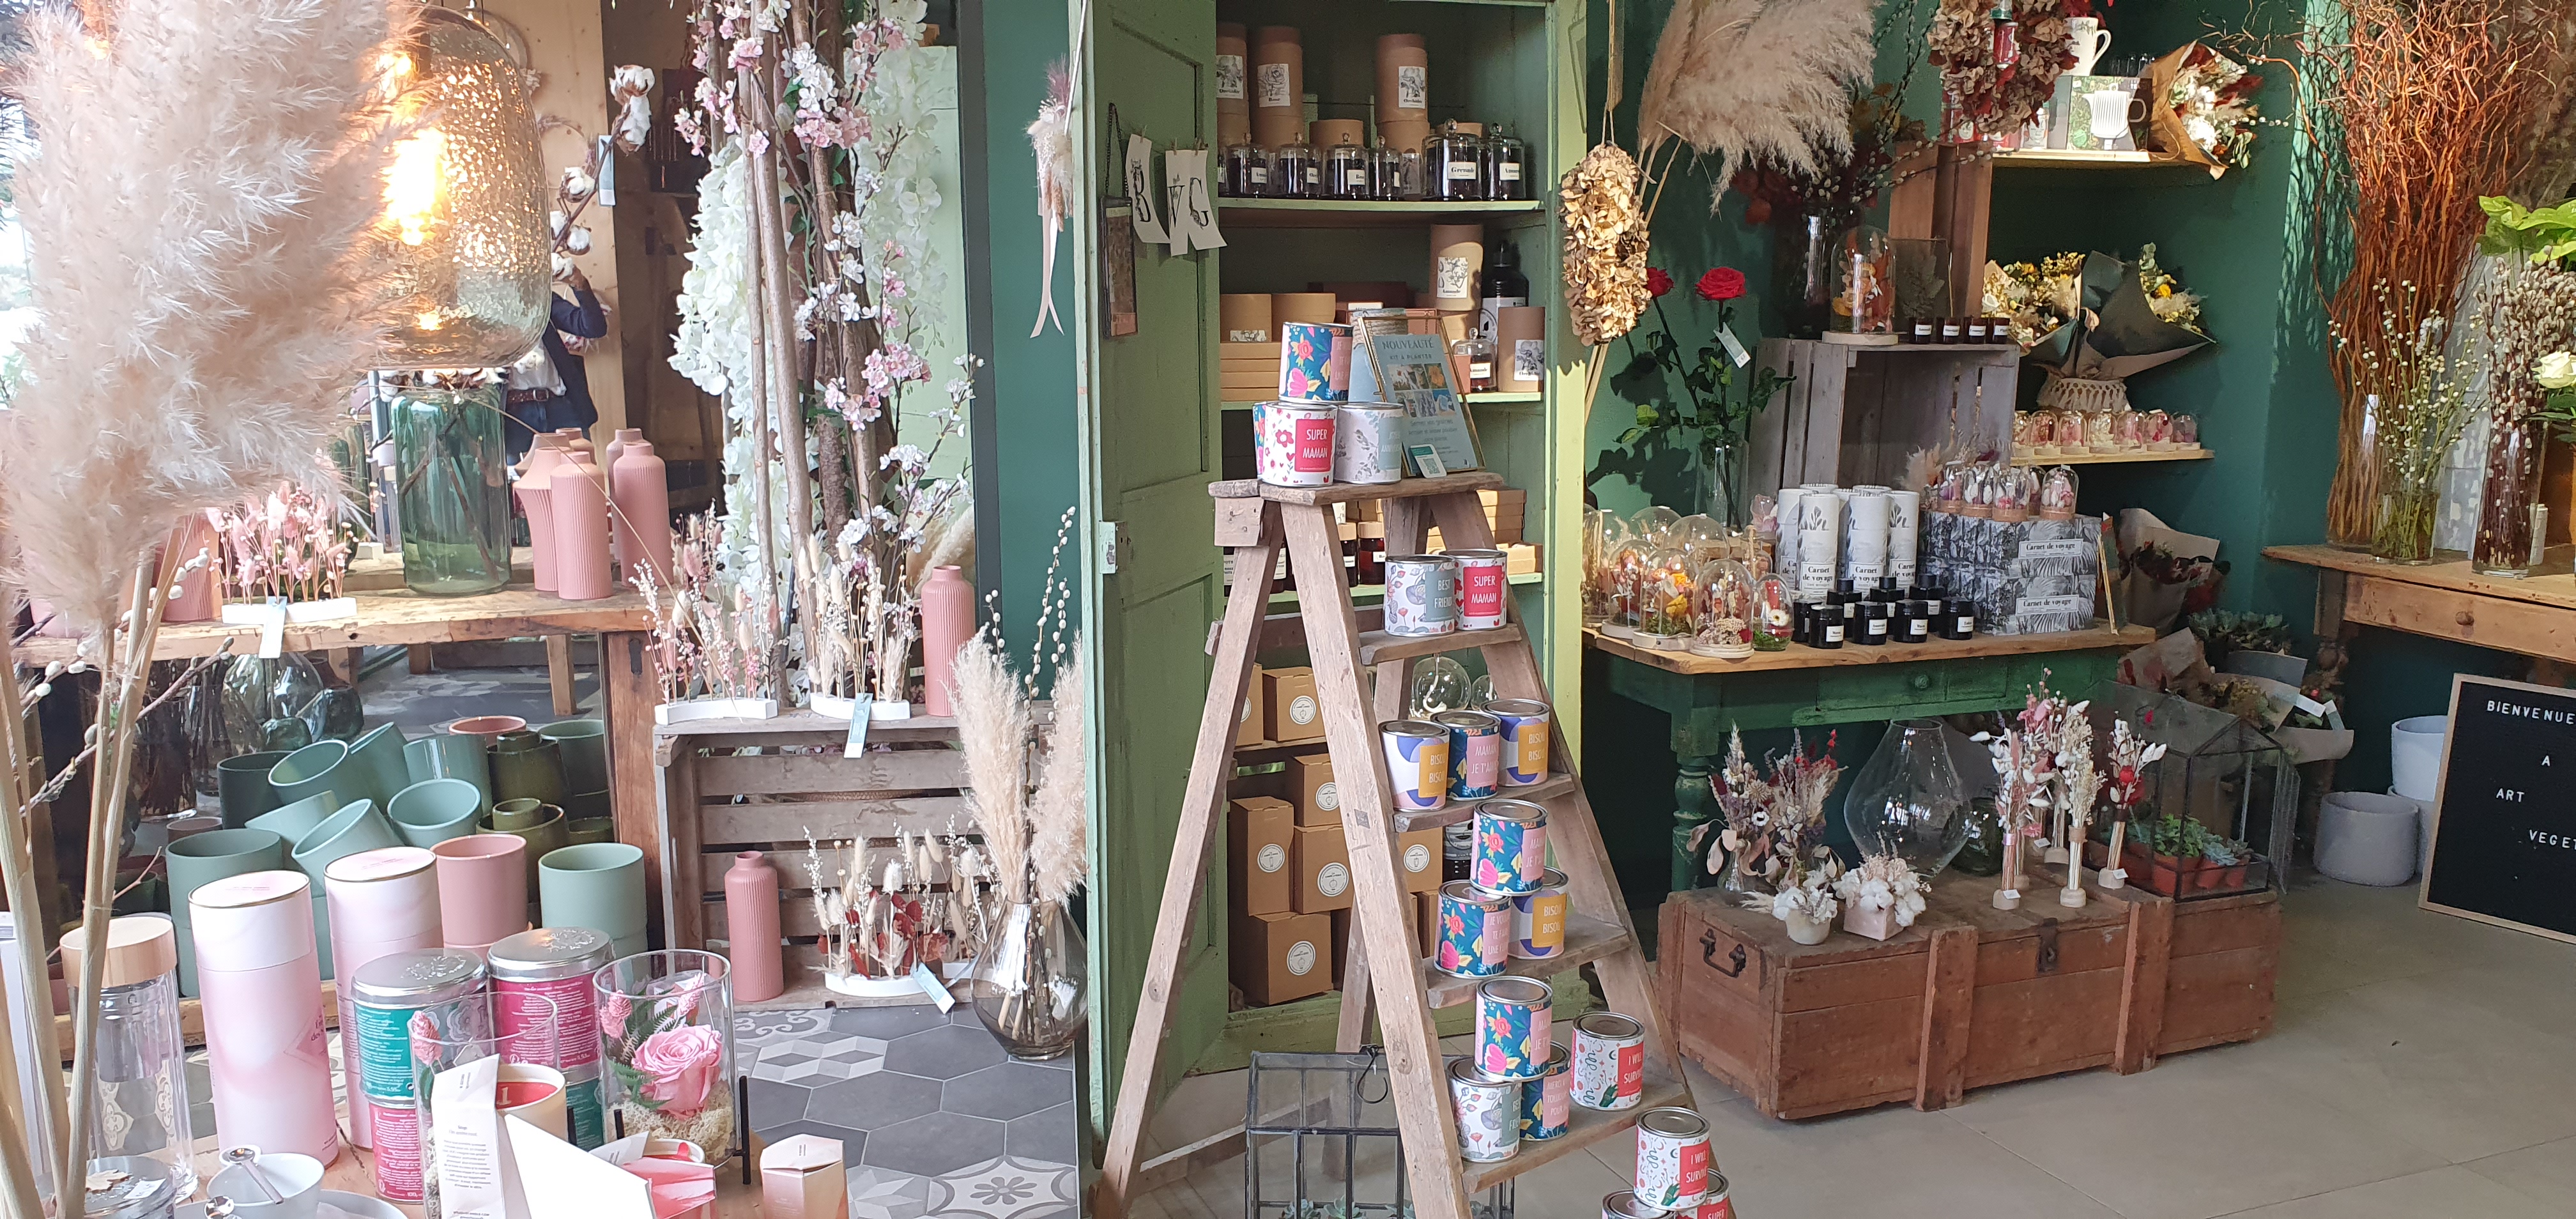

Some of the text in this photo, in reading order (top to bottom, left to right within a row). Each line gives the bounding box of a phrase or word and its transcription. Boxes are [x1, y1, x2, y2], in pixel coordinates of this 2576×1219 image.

[1382, 337, 1434, 349] NOUVEAUTÉ
[1307, 429, 1328, 440] SUPER
[1302, 447, 1328, 459] MAMAN
[1438, 579, 1450, 591] BEST
[1474, 575, 1495, 587] SUPER
[1471, 592, 1496, 604] MAMAN
[2487, 700, 2575, 724] BIENVENUE
[2542, 755, 2551, 767] A
[1471, 762, 1479, 774] JE
[2496, 788, 2525, 802] ART
[1544, 903, 1562, 916] BISOU
[1543, 921, 1561, 934] BISOU
[1628, 1055, 1631, 1066] I
[1690, 1154, 1693, 1165] I
